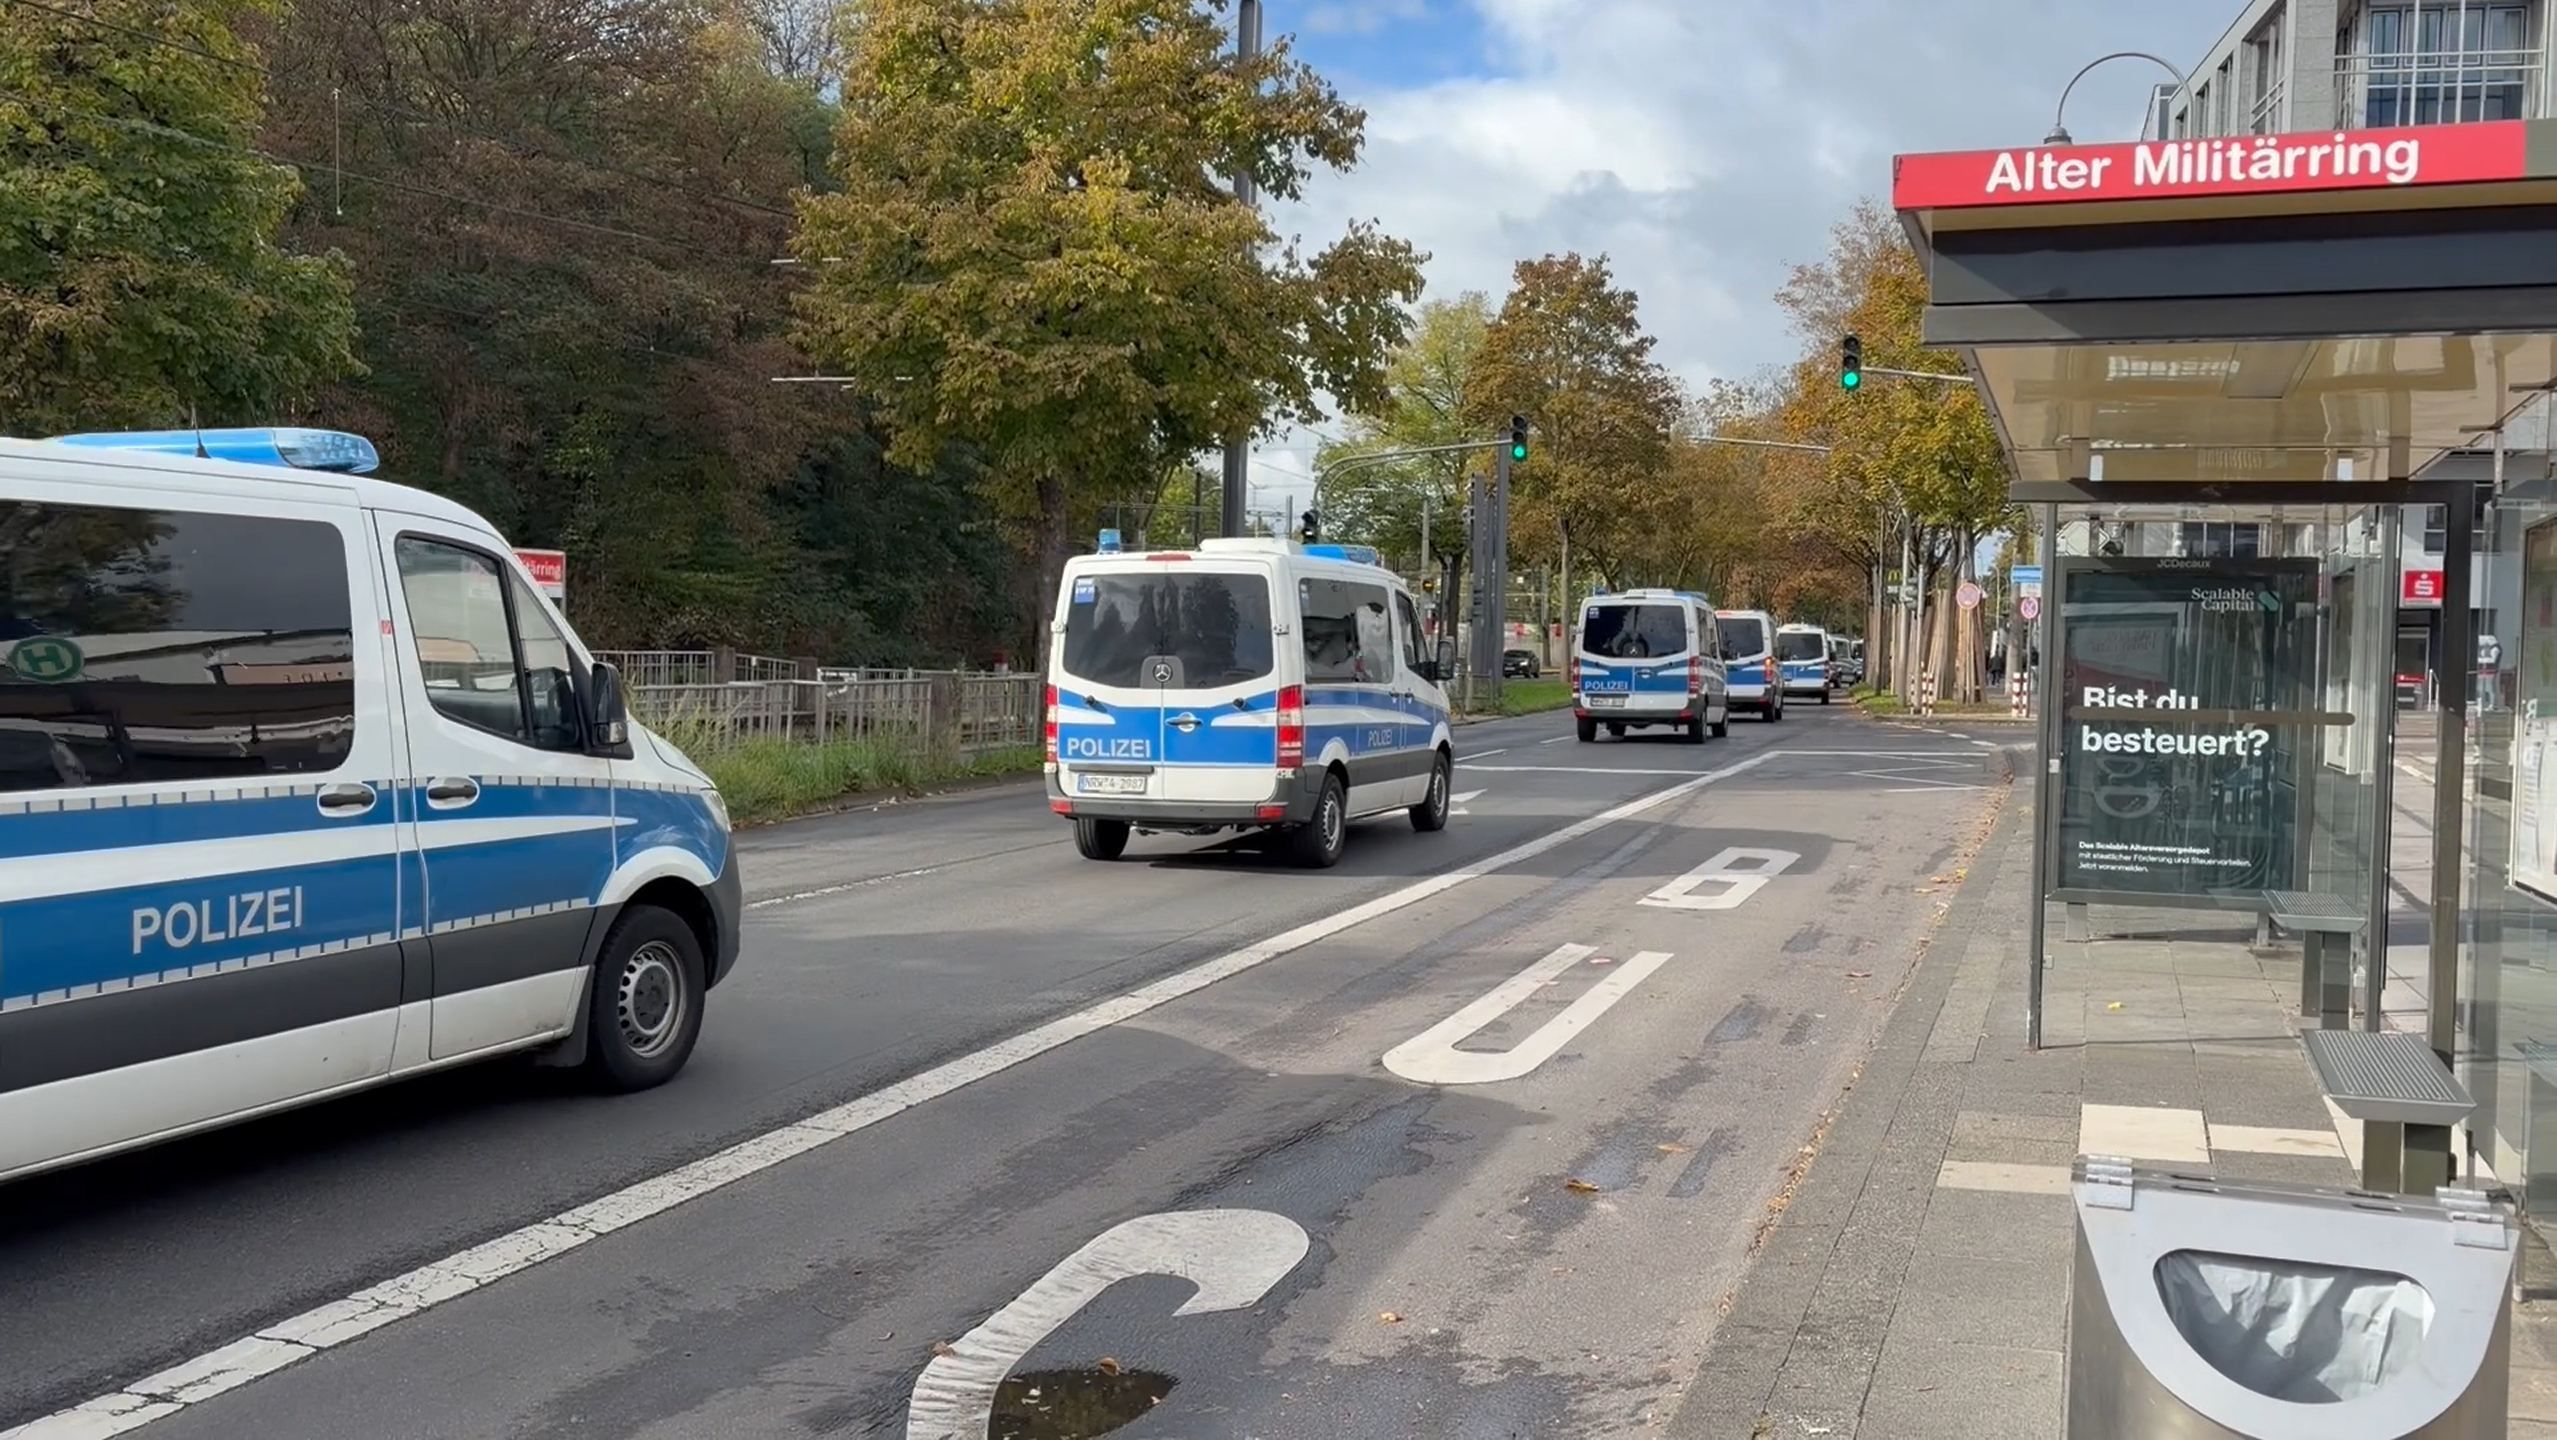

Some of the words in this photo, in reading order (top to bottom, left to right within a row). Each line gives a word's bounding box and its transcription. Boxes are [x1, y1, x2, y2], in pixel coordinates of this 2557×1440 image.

[1985, 151, 2112, 193] Alter
[2134, 133, 2420, 185] Militärring
[2157, 559, 2211, 568] JCDecaux
[2191, 587, 2255, 600] Scalable
[2201, 600, 2255, 613] Capital
[1584, 681, 1628, 690] POLIZEI
[2083, 686, 2148, 708] Bist
[2155, 689, 2198, 709] du
[1368, 728, 1392, 747] POLIZEI
[2081, 725, 2269, 756] besteuert?
[1067, 737, 1151, 758] POLIZEI
[2078, 862, 2097, 870] Jetzt
[2133, 854, 2172, 864] Förderung
[2174, 856, 2190, 864] und
[132, 885, 303, 954] POLIZEI
